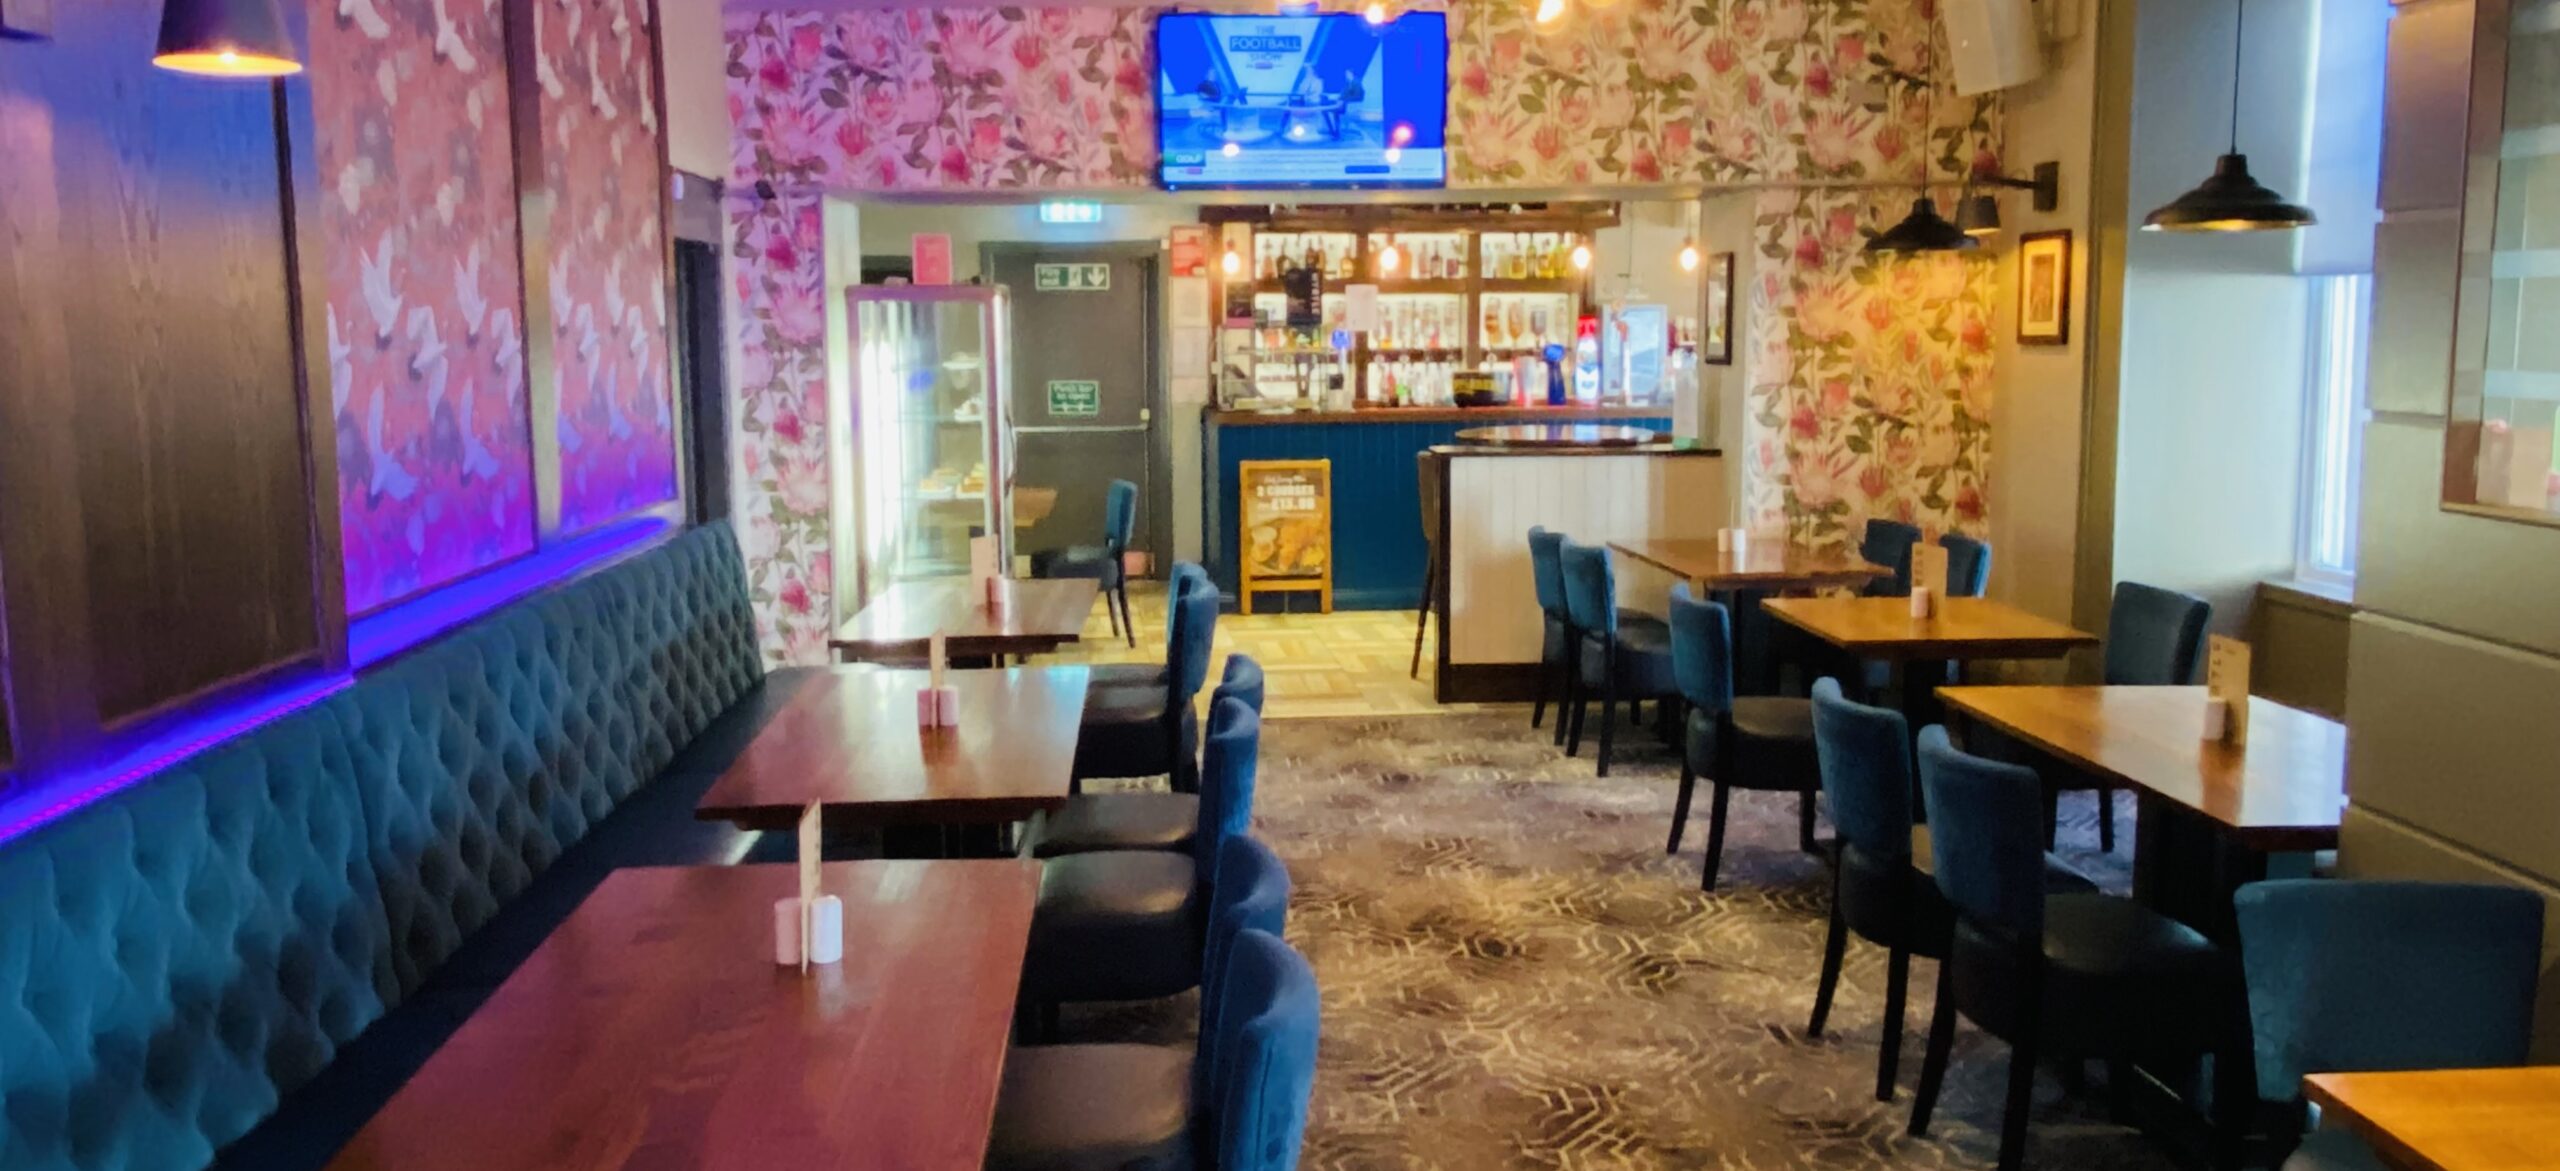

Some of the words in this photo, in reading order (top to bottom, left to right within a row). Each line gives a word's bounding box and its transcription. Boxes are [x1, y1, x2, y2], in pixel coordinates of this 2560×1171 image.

[1255, 25, 1275, 34] THE
[1231, 37, 1300, 50] FOOTBALL
[1249, 53, 1283, 61] SHOW
[1176, 153, 1203, 163] GOLF
[1266, 484, 1315, 497] COURSES
